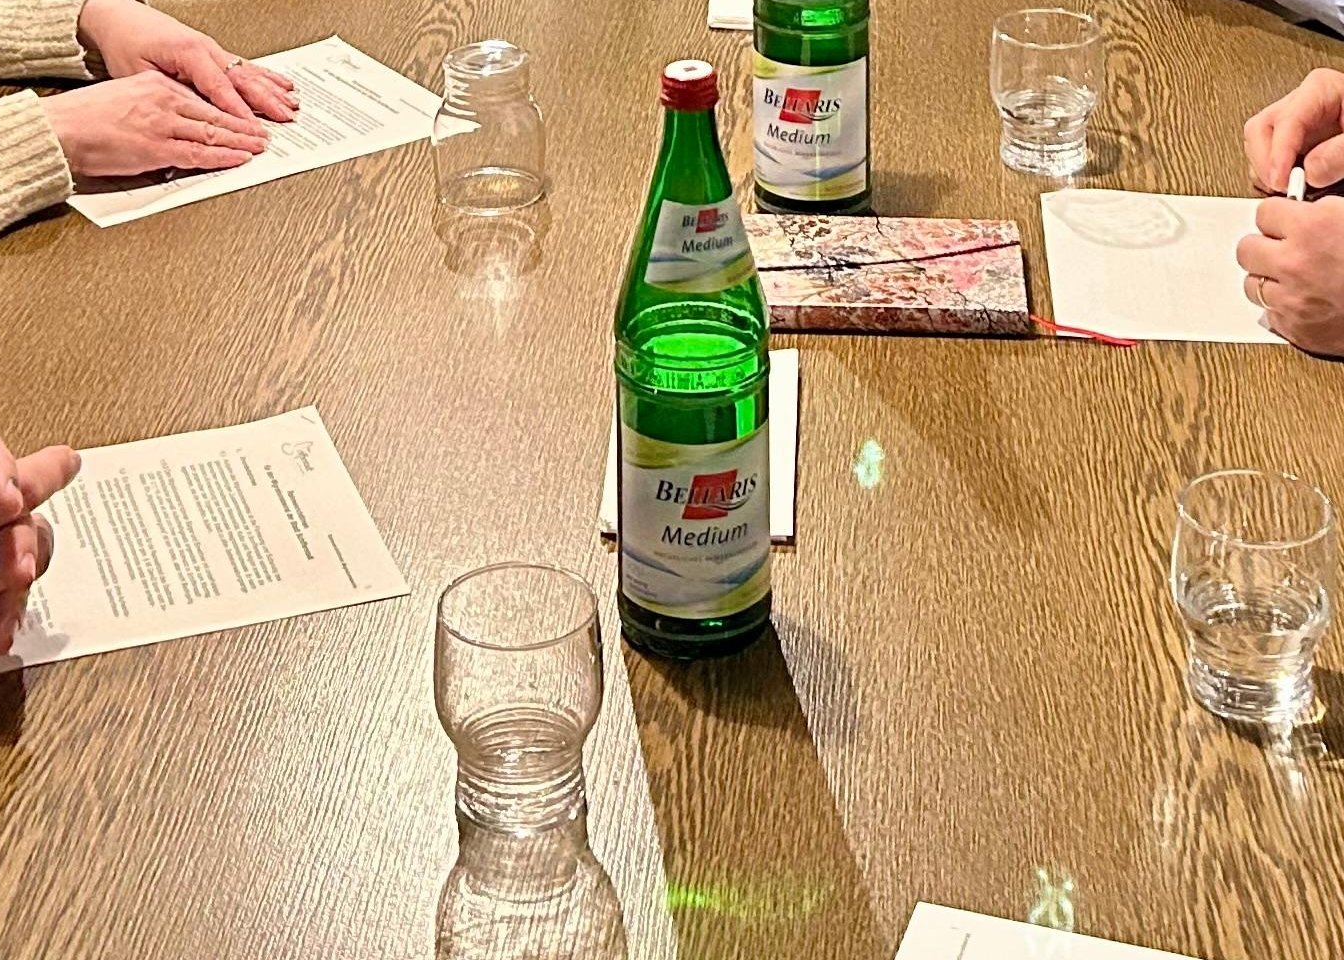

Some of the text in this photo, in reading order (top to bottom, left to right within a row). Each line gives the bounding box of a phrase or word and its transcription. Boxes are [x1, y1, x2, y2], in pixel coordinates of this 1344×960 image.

[766, 123, 831, 146] Medium
[681, 235, 734, 254] Medium
[661, 522, 749, 548] Medium
